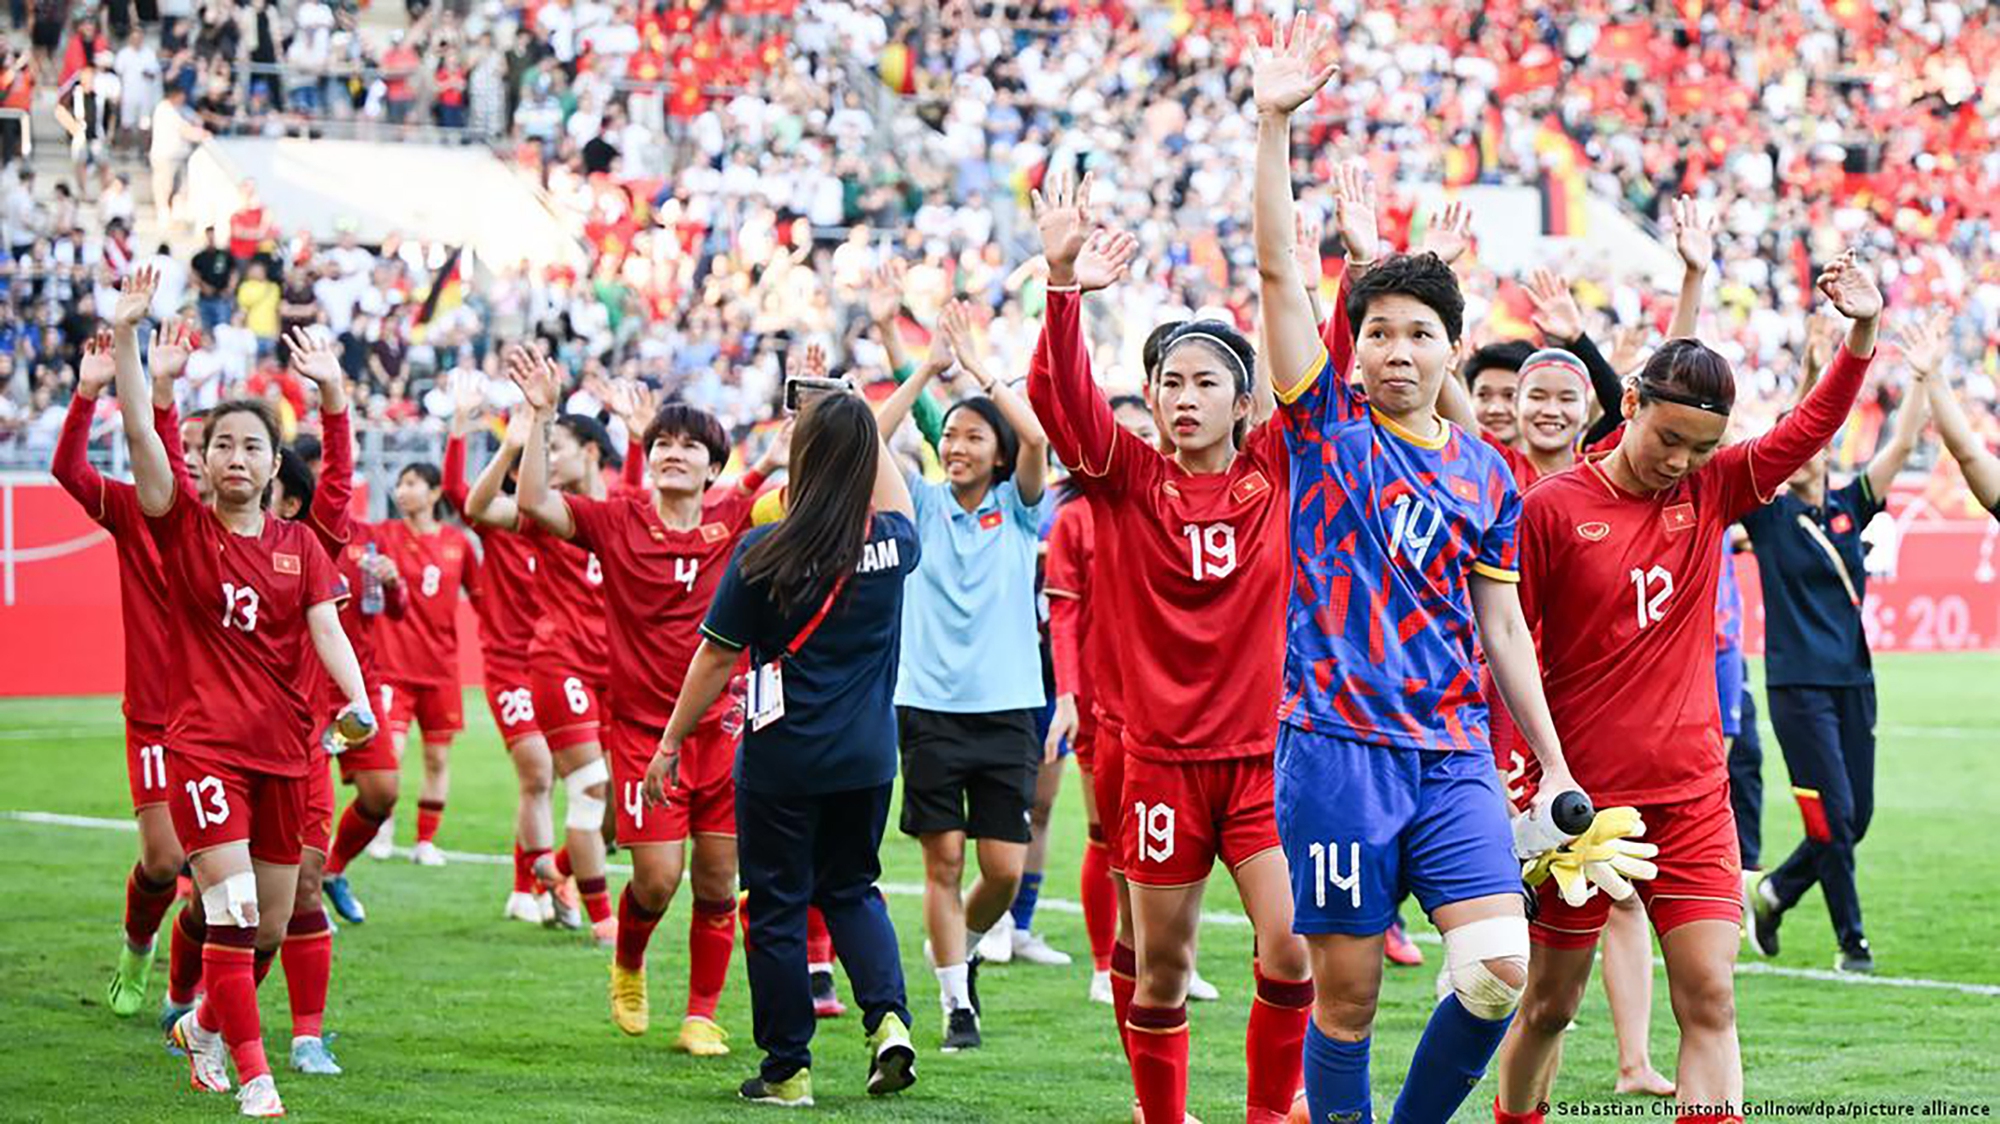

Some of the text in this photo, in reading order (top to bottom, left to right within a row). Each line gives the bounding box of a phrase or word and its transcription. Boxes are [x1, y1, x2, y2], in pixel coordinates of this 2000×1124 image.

[1184, 523, 1237, 581] 19
[1389, 490, 1442, 571] 14
[421, 564, 442, 597] 8
[674, 557, 698, 591] 4
[1630, 565, 1674, 629] 12
[222, 582, 260, 632] 13
[497, 687, 535, 726] 26
[563, 676, 590, 715] 6
[140, 745, 166, 789] 11
[185, 775, 230, 829] 13
[624, 781, 645, 829] 4
[1134, 801, 1175, 863] 19
[1309, 841, 1361, 908] 14
